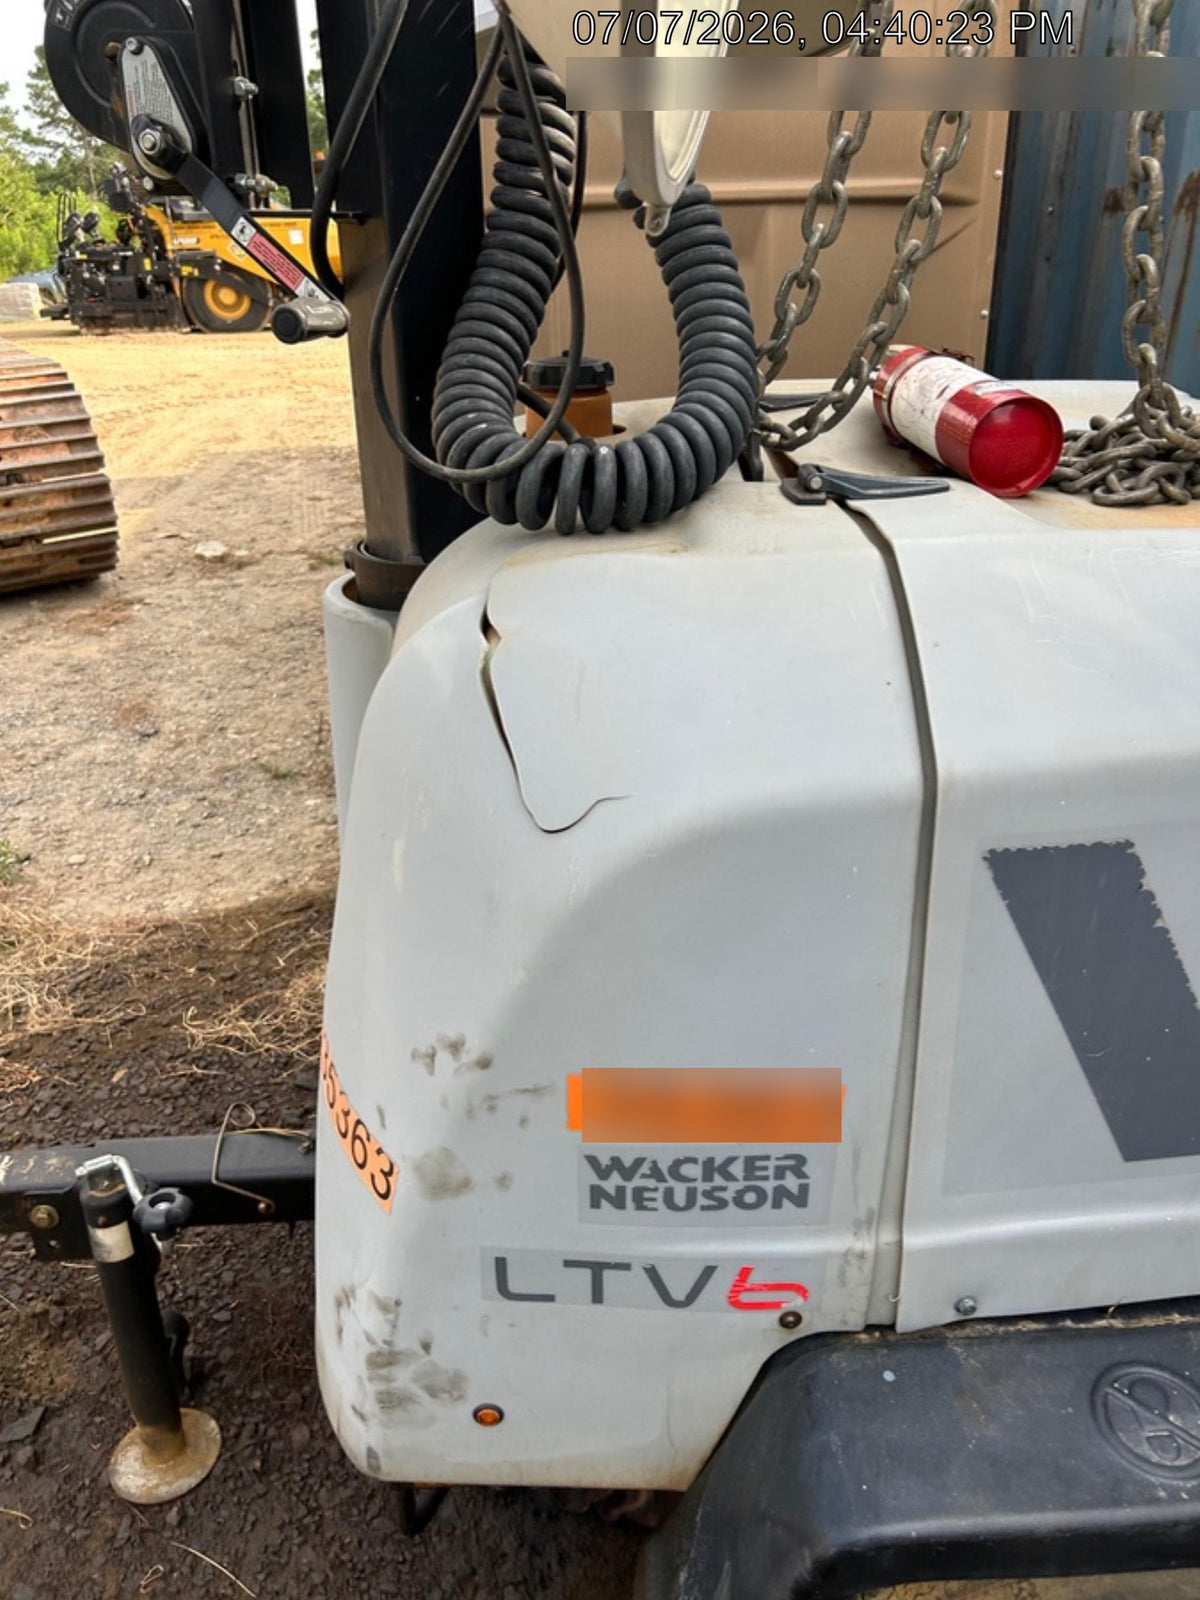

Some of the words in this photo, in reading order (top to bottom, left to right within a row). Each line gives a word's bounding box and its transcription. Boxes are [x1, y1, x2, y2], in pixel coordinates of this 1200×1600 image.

[584, 1153, 811, 1183] WACKER
[589, 1183, 810, 1213] NEUSON
[493, 1256, 811, 1311] LTV6
